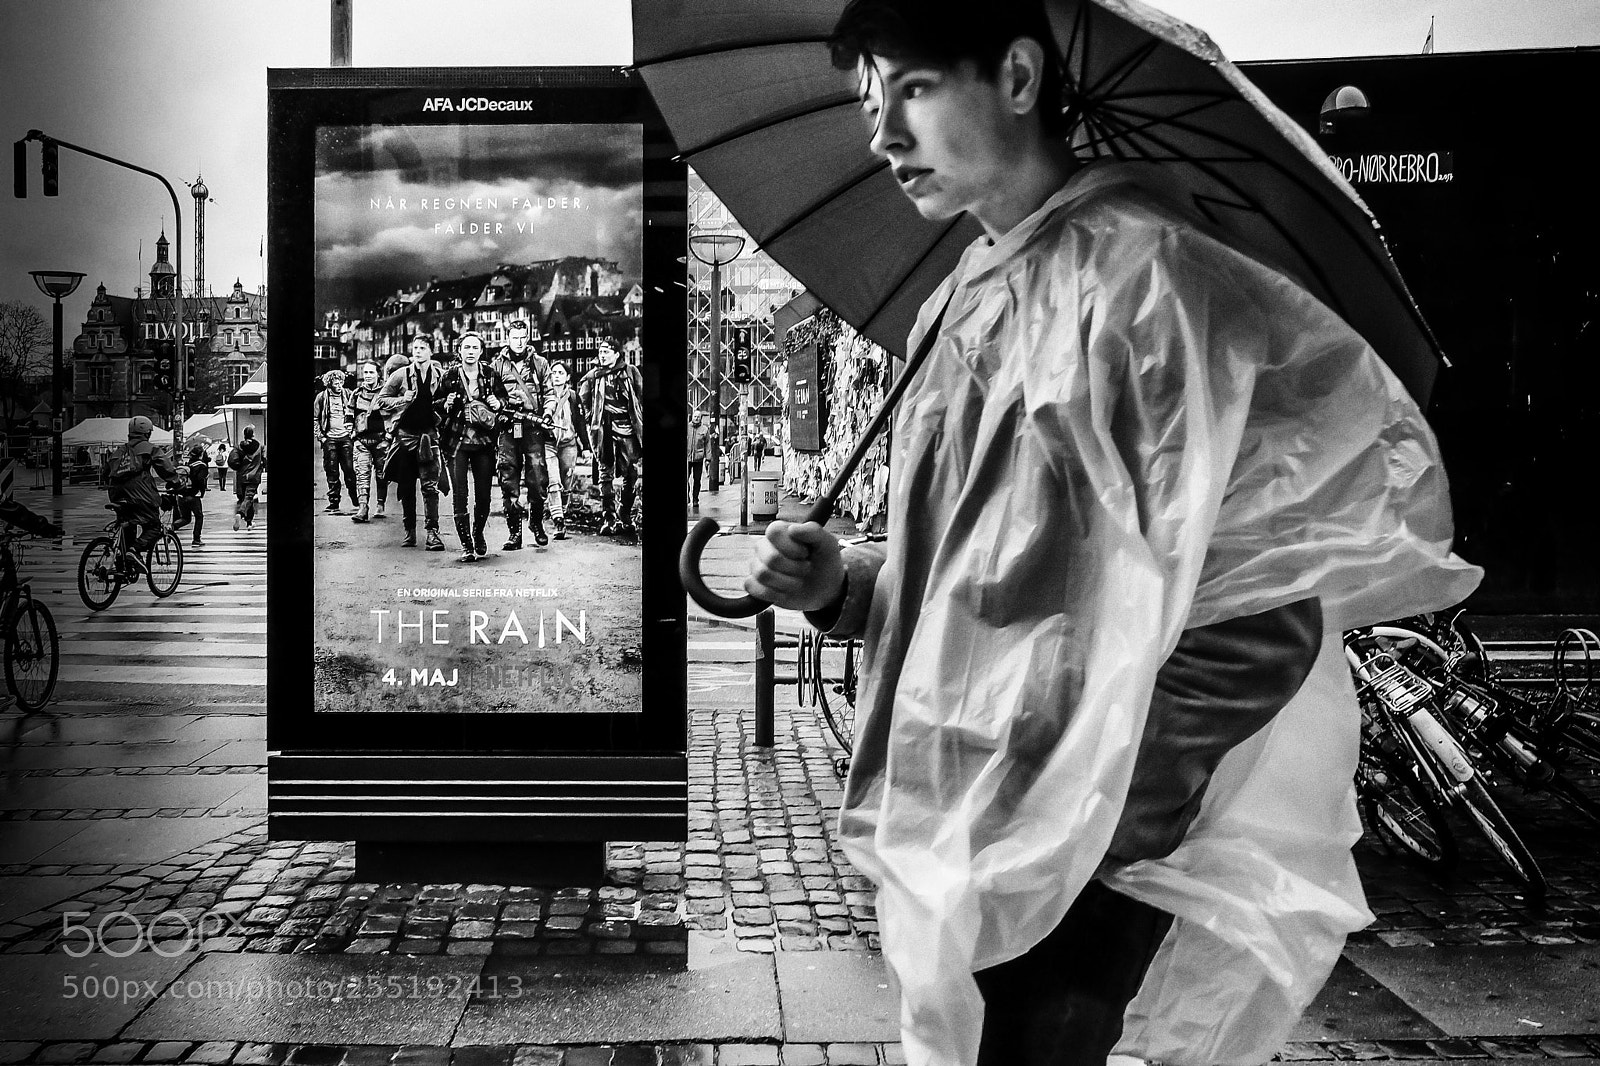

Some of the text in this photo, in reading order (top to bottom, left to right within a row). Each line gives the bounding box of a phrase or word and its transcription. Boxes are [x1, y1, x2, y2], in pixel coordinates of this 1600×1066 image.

[422, 97, 533, 112] AFA JCDecaux
[370, 195, 590, 211] NÅR REGNEN FALDER,
[434, 222, 535, 235] FALDER VI
[397, 588, 558, 598] EN ORIGINAL SERIE FRA NETFLIX
[370, 608, 586, 649] THE RAIN
[381, 665, 573, 689] 4. MAJ NETFLIX
